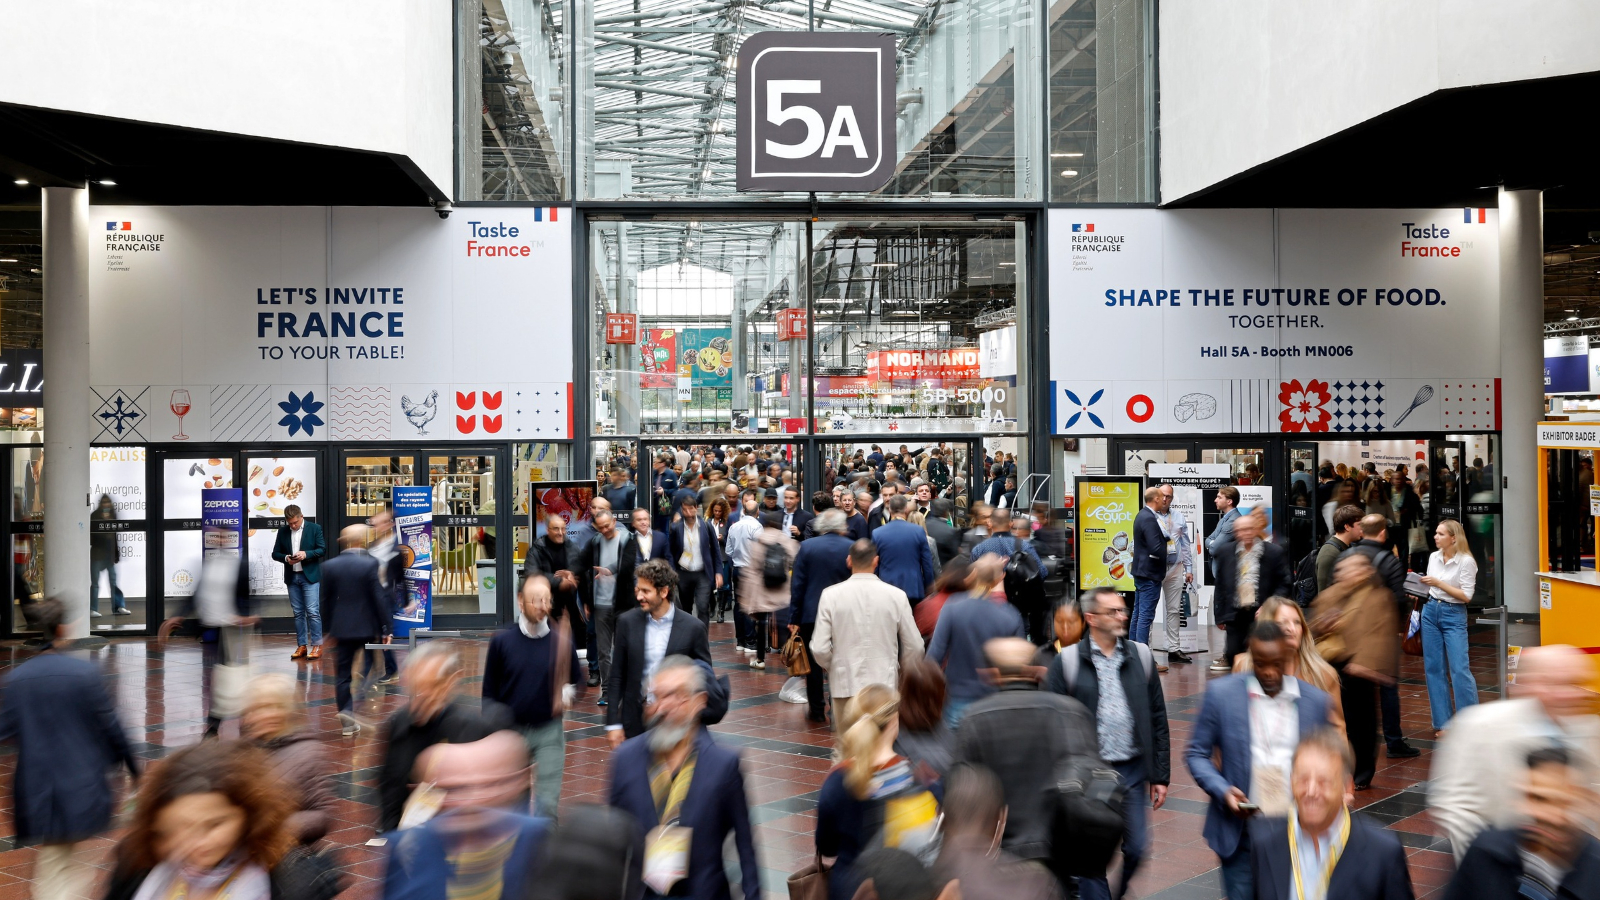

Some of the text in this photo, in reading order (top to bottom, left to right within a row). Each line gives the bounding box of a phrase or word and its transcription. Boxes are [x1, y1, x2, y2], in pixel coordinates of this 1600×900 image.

[766, 80, 869, 159] 5A
[467, 221, 519, 238] Taste
[1402, 223, 1450, 239] Taste
[106, 232, 165, 243] RÉPUBLIQUE
[1071, 234, 1125, 244] RÉPUBLIQUE
[106, 243, 161, 252] FRANÇAISE
[467, 240, 544, 257] France TM
[1071, 244, 1121, 253] FRANÇAISE
[1401, 241, 1473, 257] France TM
[257, 288, 404, 305] LET'S INVITE
[1104, 288, 1447, 307] SHAPE THE FUTURE OF FOOD.
[257, 311, 404, 338] FRANCE
[1228, 315, 1324, 329] TOGETHER.
[258, 346, 404, 360] TO YOUR TABLE!
[1201, 346, 1227, 358] Hall
[1231, 346, 1250, 357] 5A
[1261, 346, 1301, 357] Booth
[1305, 345, 1354, 357] MN006
[828, 388, 864, 396] espaces
[1542, 431, 1596, 441] EXHIBITOR BADGE
[1178, 466, 1199, 475] SIAL
[95, 483, 142, 497] Auvergne,
[204, 518, 239, 526] 4 TITRES
[1095, 509, 1133, 524] Egypt
